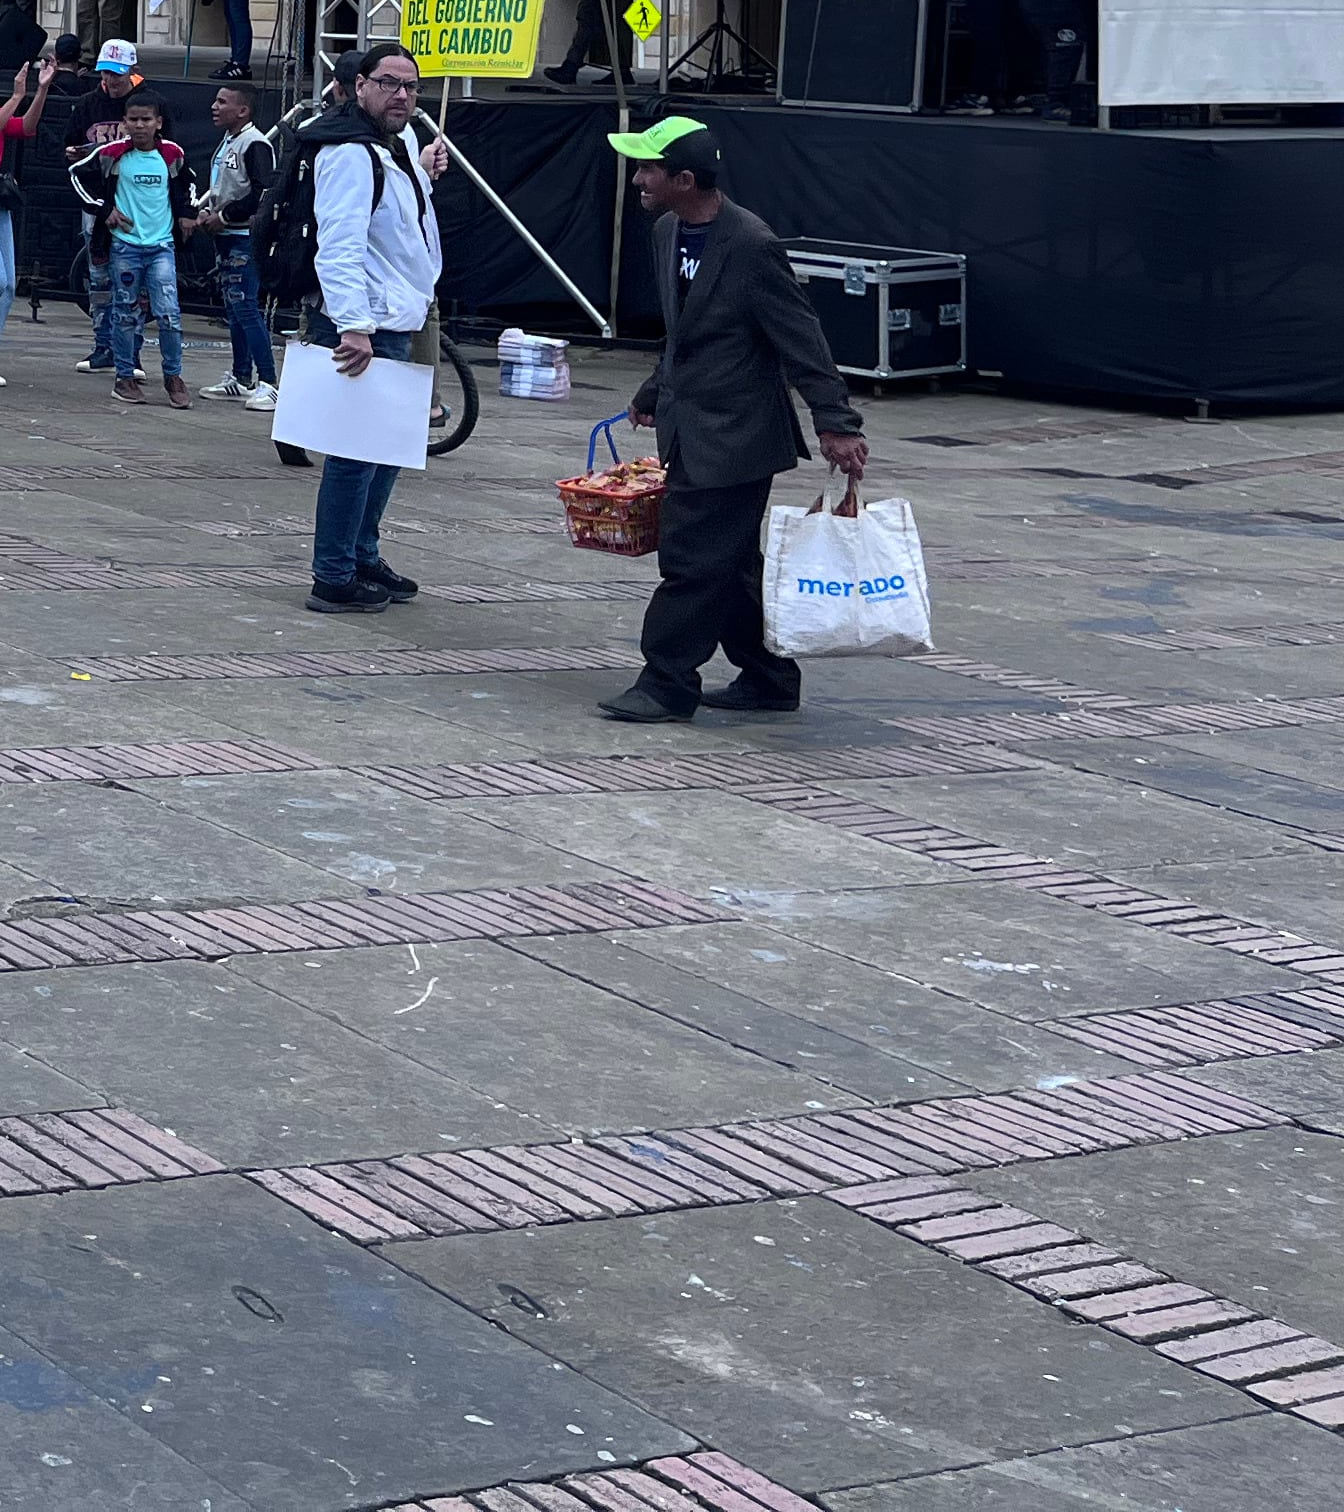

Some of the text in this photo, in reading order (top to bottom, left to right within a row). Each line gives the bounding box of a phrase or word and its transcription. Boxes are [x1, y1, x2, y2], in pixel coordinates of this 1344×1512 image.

[408, 0, 429, 26] DEL
[411, 28, 513, 56] DEL CAMBIO
